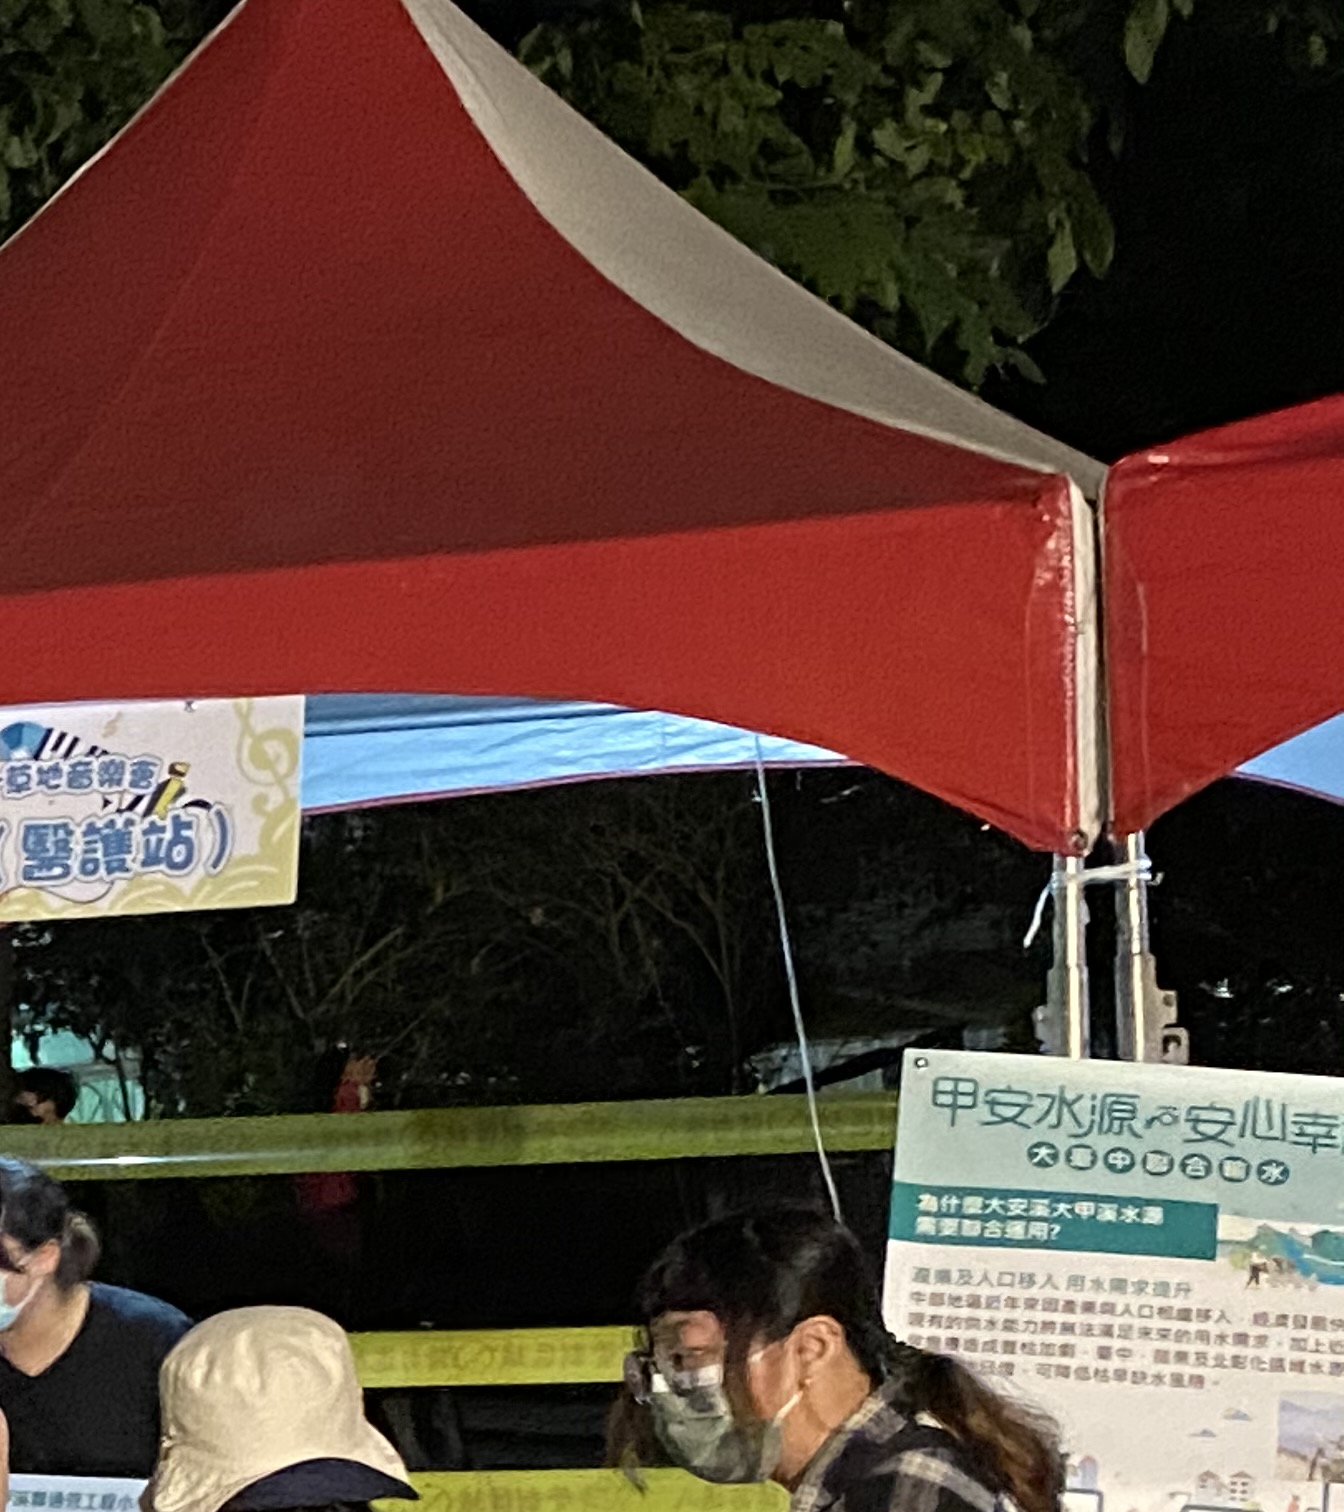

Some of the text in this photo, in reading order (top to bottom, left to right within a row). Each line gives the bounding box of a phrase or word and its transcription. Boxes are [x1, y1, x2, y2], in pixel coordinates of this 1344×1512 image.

[931, 1076, 1344, 1155] 甲安水源 安心幸
